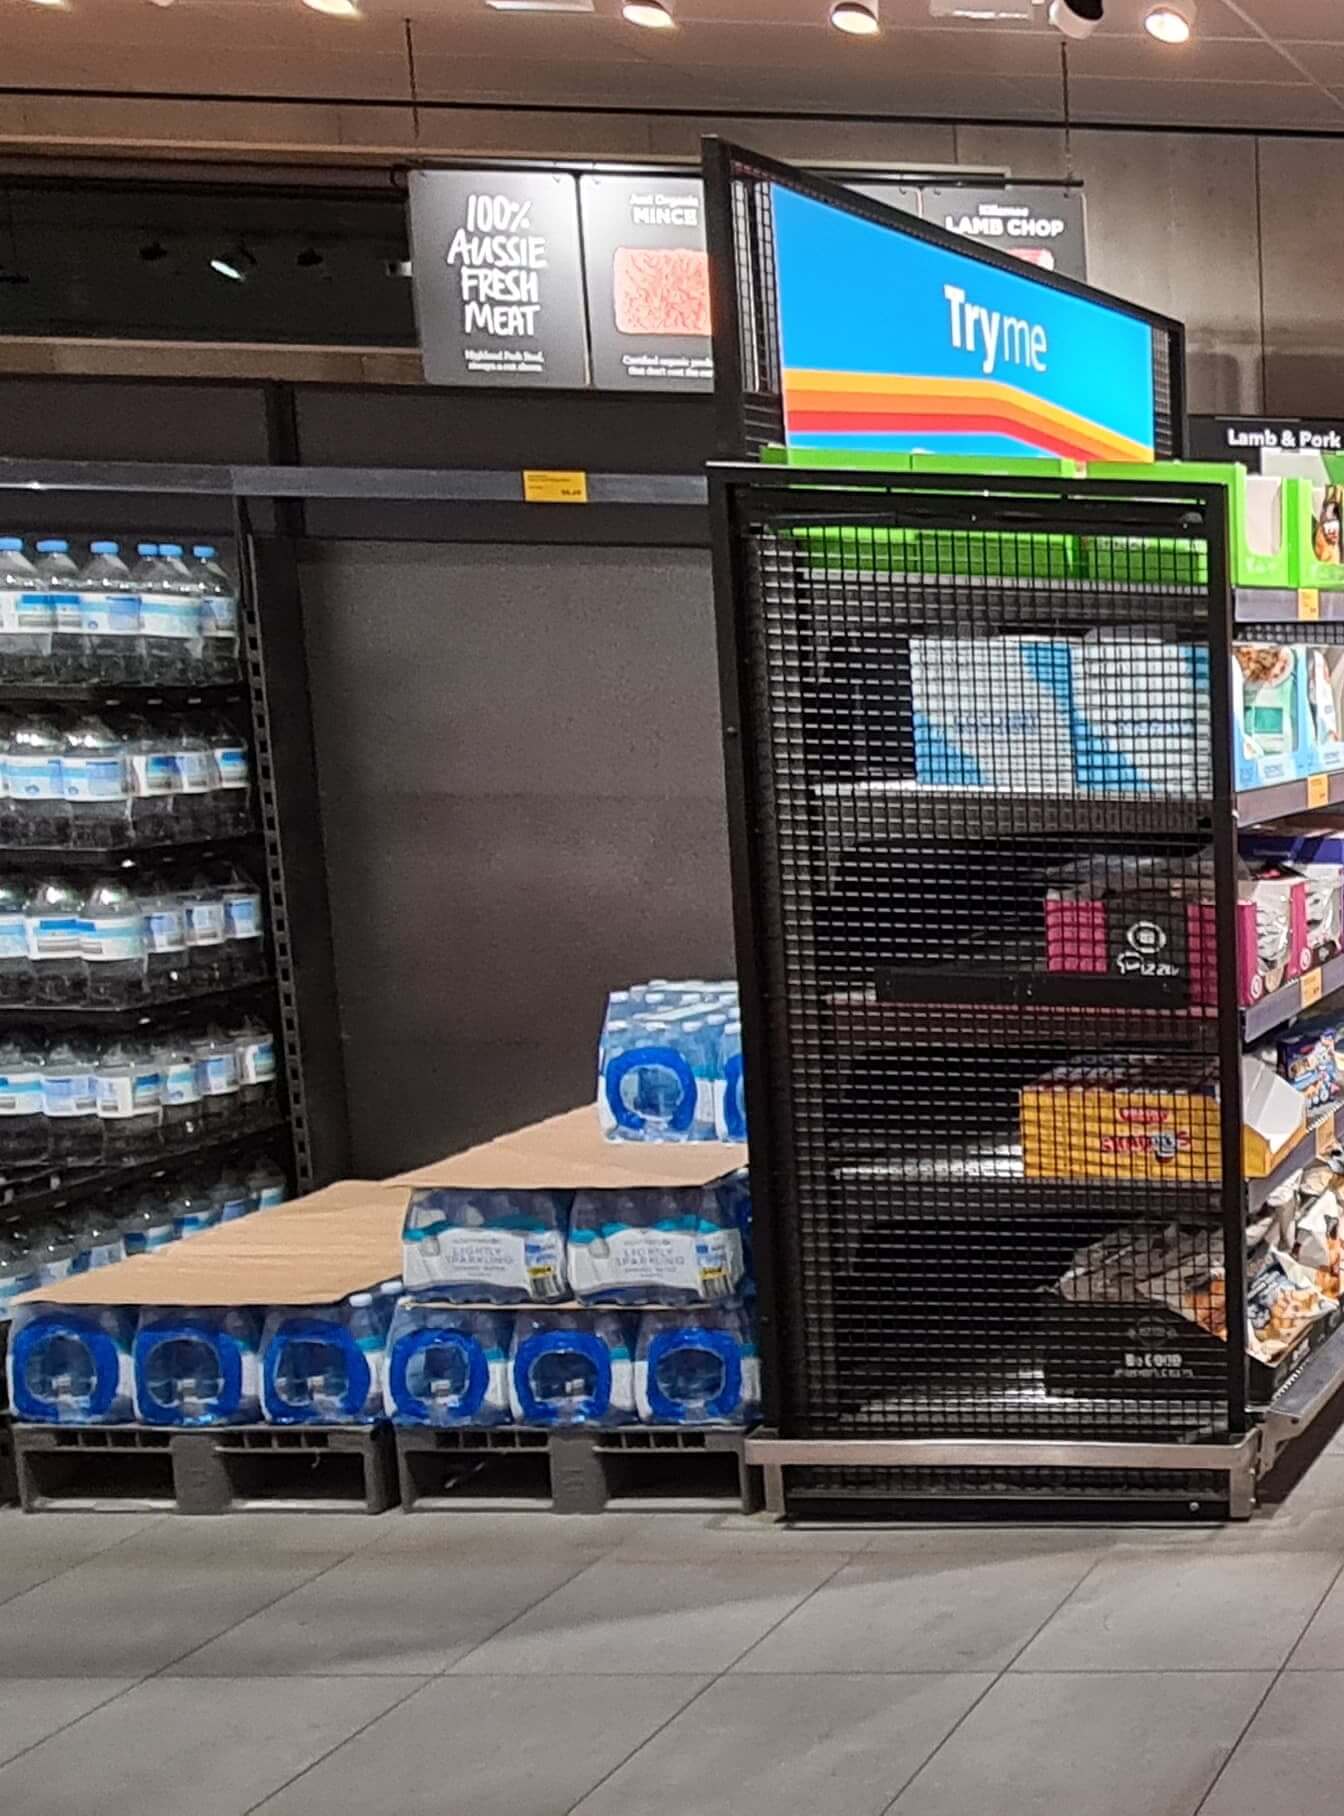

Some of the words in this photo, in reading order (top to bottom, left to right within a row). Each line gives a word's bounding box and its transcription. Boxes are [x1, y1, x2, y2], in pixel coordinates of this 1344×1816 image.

[467, 194, 532, 232] 100%
[632, 207, 698, 226] MINCE
[945, 215, 1003, 236] LAMB
[1007, 217, 1065, 237] CHOP
[447, 227, 549, 269] AUSSIE
[461, 265, 539, 303] FRESH
[464, 301, 541, 336] MEAT
[1227, 428, 1279, 448] Lamb
[1283, 430, 1296, 447] &
[1298, 430, 1341, 449] Pork
